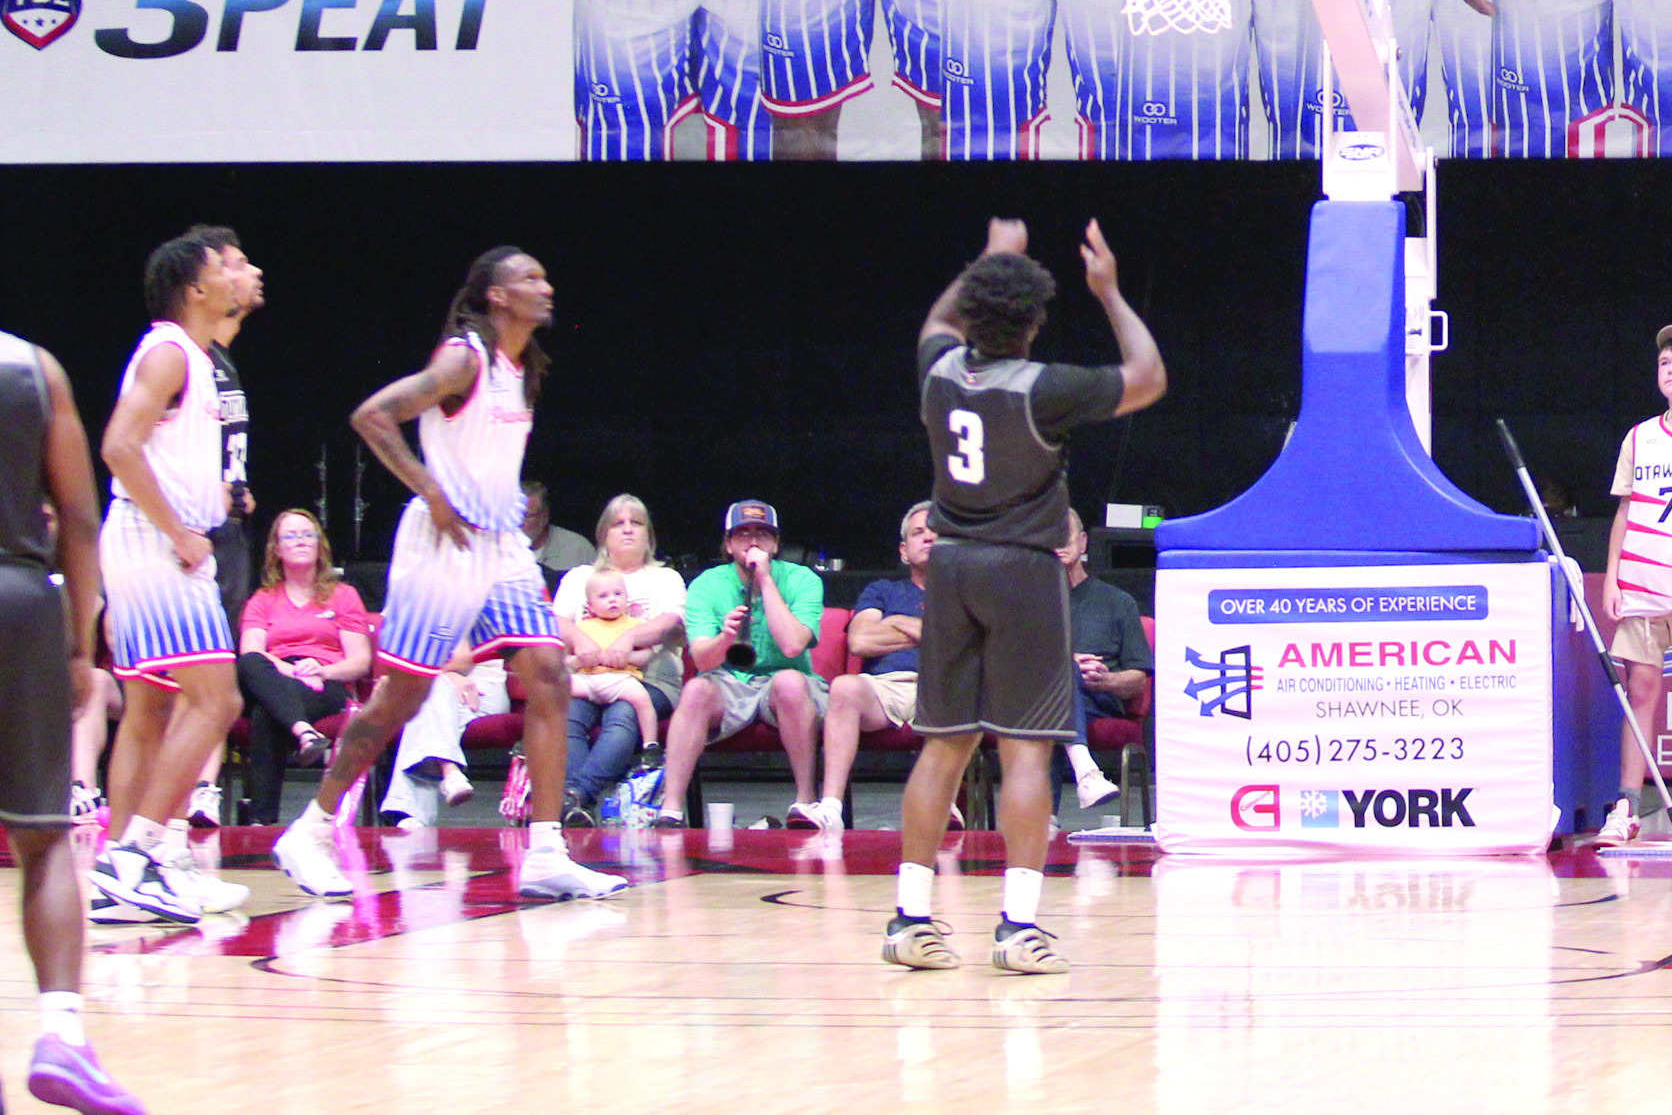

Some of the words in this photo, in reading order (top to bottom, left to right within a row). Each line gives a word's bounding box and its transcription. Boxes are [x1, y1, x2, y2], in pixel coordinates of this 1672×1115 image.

[1133, 115, 1178, 126] WOOTER
[947, 408, 985, 486] 3
[1219, 599, 1266, 616] OVER
[1269, 598, 1292, 615] 40
[1295, 597, 1347, 614] YEARS
[1350, 596, 1375, 613] OF
[1378, 594, 1477, 613] EXPERIENCE
[1277, 639, 1517, 668] AMERICAN
[1277, 677, 1297, 692] AIR
[1299, 676, 1384, 693] CONDITIONING
[1394, 675, 1446, 691] HEATING
[1459, 674, 1517, 690] ELECTRIC
[1315, 699, 1425, 720] SHAWNEE,
[1431, 698, 1465, 717] OK
[1342, 787, 1476, 829] YORK
